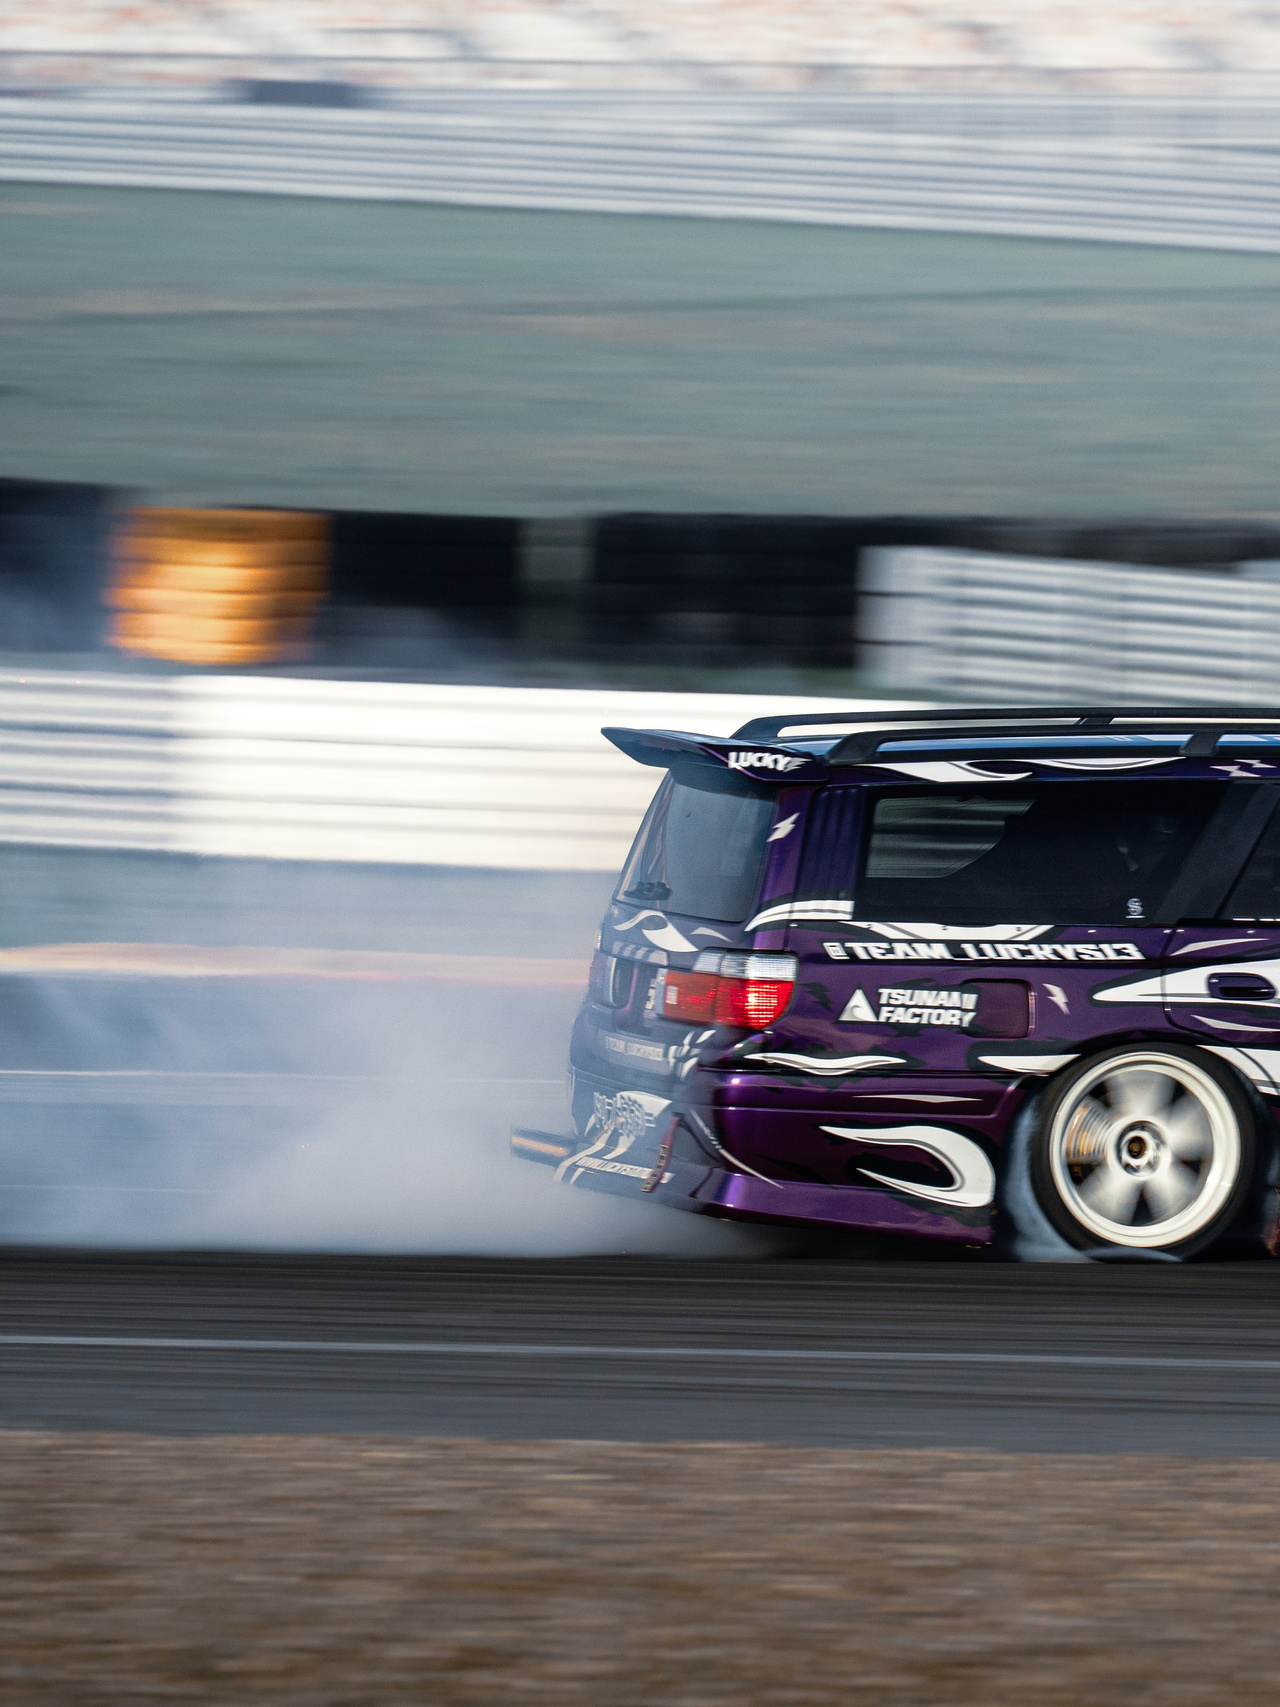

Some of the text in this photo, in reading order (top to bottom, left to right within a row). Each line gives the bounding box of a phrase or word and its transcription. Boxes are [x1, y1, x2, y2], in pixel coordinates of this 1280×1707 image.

[728, 752, 791, 771] LUCKY
[822, 942, 1146, 961] @TEAM_LUCKYS13
[878, 988, 978, 1009] TSUNAMI
[878, 1006, 977, 1027] FACTORY
